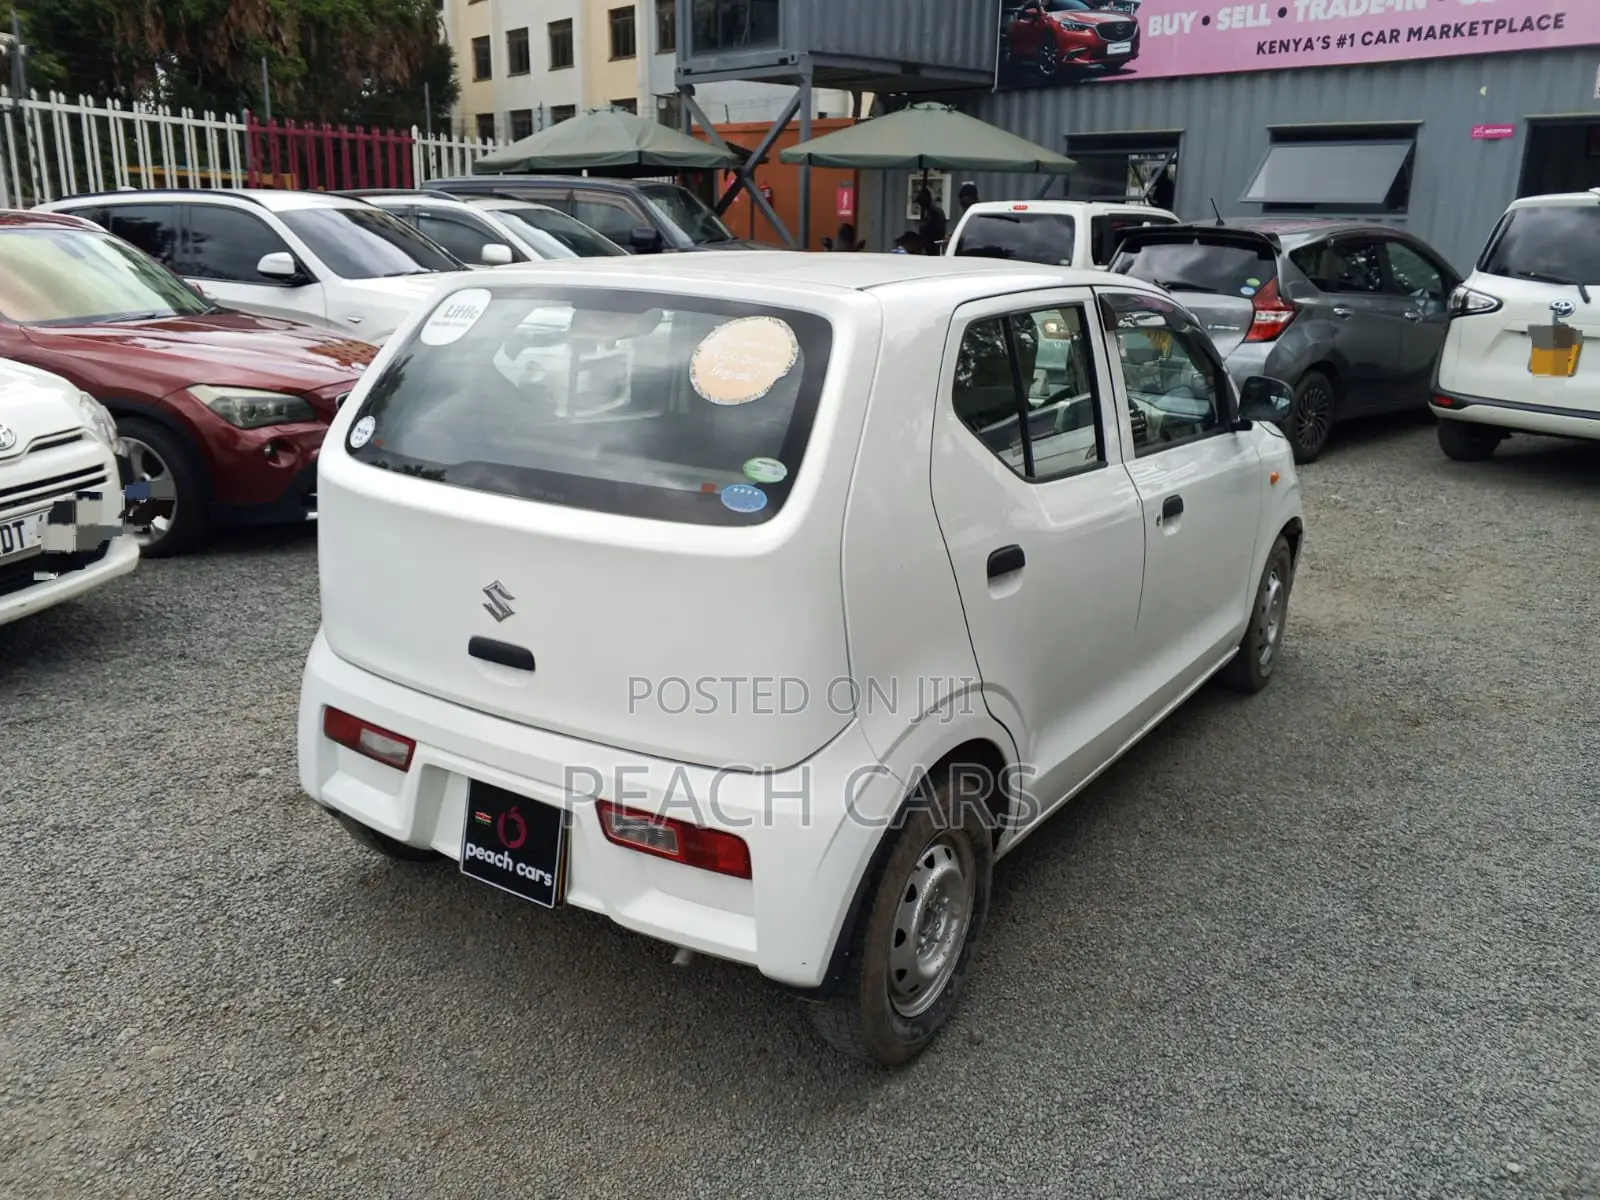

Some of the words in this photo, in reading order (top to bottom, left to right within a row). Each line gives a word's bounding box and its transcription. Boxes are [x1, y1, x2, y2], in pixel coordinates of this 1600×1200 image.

[1148, 11, 1198, 37] BUY
[1216, 3, 1272, 31] SELL
[1256, 35, 1331, 55] KENYA'S
[1336, 33, 1356, 49] #1
[1361, 28, 1401, 47] CAR
[1406, 12, 1566, 42] MARKETPLACE
[465, 842, 514, 872] peach
[516, 862, 553, 887] cars
